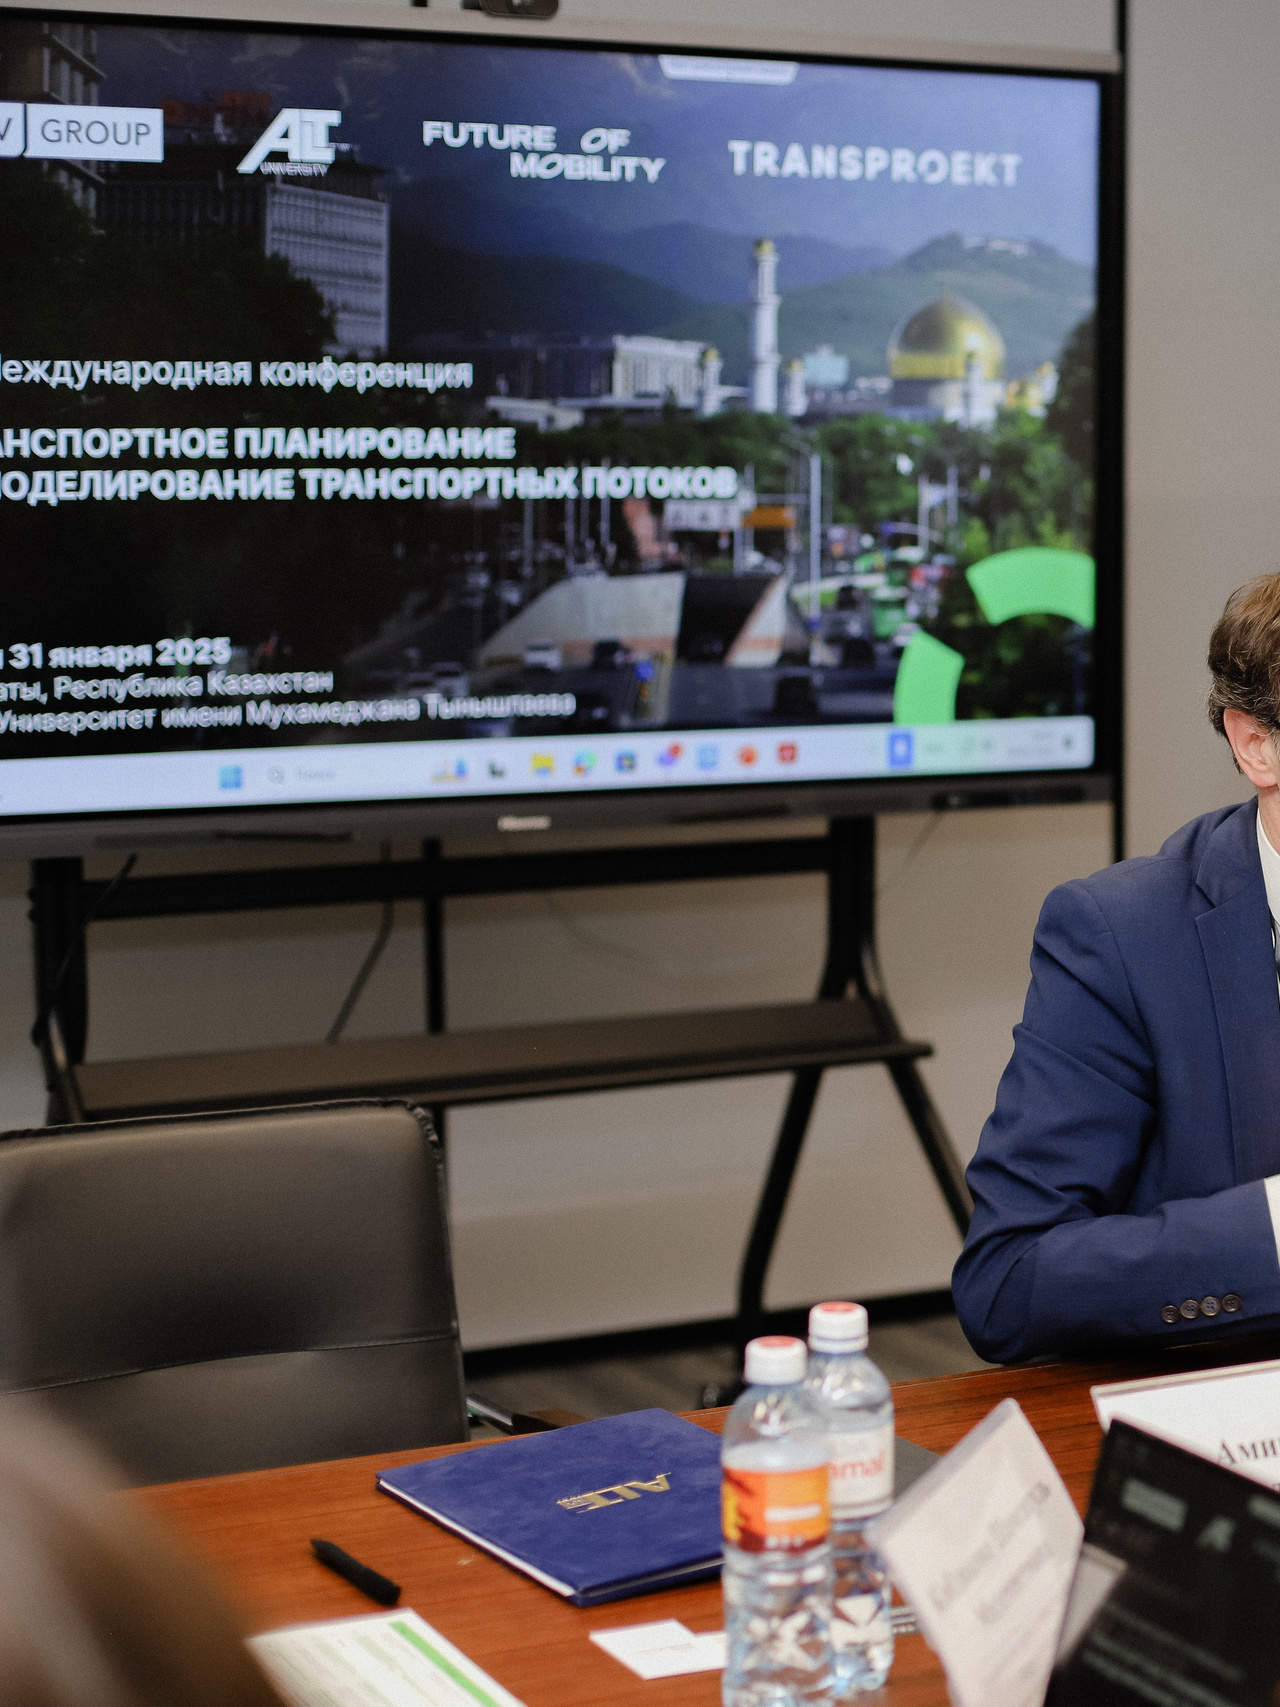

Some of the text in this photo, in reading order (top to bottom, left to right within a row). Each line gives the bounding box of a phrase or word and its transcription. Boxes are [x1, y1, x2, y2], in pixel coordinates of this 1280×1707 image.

[41, 118, 151, 146] GROUP
[422, 120, 632, 154] FUTURE OF
[259, 161, 330, 177] UNIVERSITY
[509, 151, 667, 183] MOBILITY
[728, 139, 1022, 187] TRANSPROEKT
[0, 356, 473, 393] еждународная конференция
[0, 427, 517, 459] НСПОРТНОЕ ПЛАНИРОВАНИЕ
[0, 466, 739, 506] ОДЕЛИРОВАНИЕ ТРАНСПОРТНЫХ ПОТОКОВ
[8, 642, 43, 669] 31
[48, 645, 153, 672] января
[155, 636, 232, 666] 2025
[53, 673, 203, 704] Республика
[207, 670, 334, 696] Казахстан
[0, 708, 157, 737] Университет
[161, 704, 242, 729] имени
